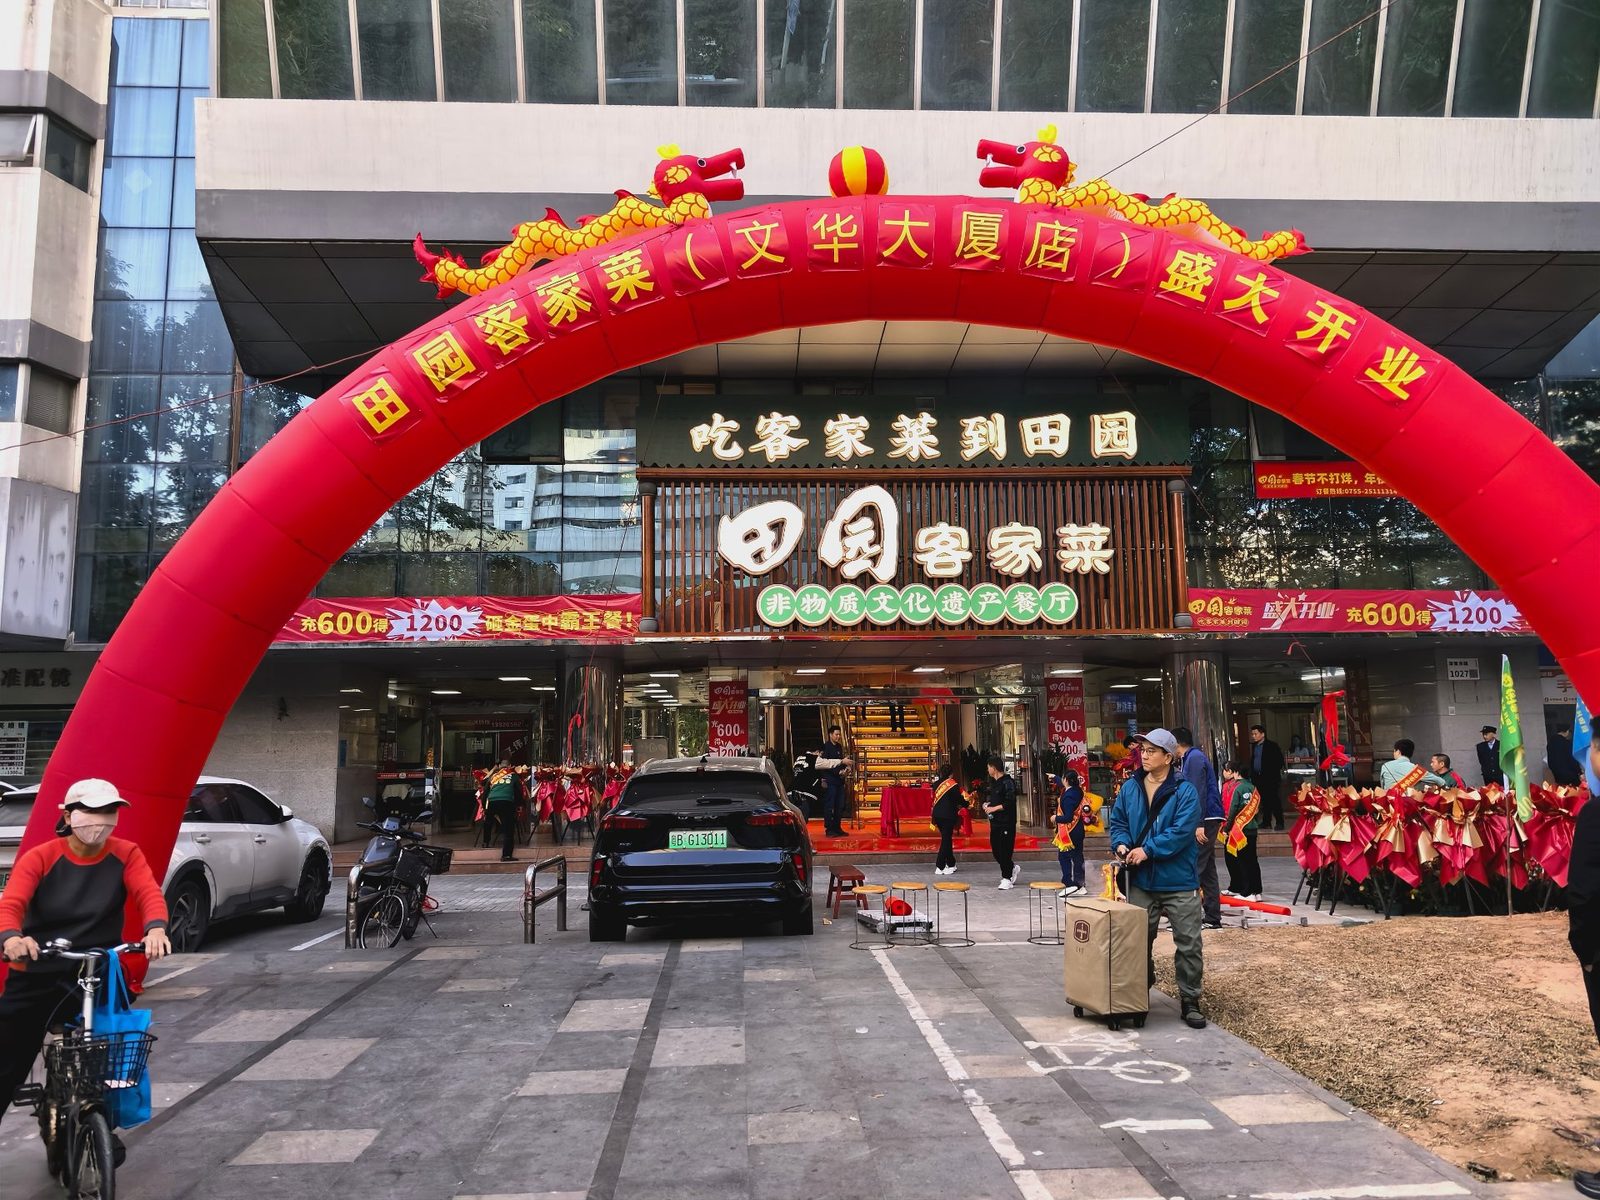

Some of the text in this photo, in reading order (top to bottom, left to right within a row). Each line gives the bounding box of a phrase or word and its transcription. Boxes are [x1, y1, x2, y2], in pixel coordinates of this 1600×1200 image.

[689, 410, 1139, 463] 吃客家菜到田园
[718, 484, 1115, 583] 田园客家菜
[765, 588, 1074, 618] 非物质文化遗产餐厅
[1188, 596, 1253, 617] 田园客家菜
[1260, 597, 1336, 630] 盛大开业
[405, 614, 463, 632] 1200
[1449, 606, 1502, 626] 1200
[1450, 670, 1469, 678] 1027
